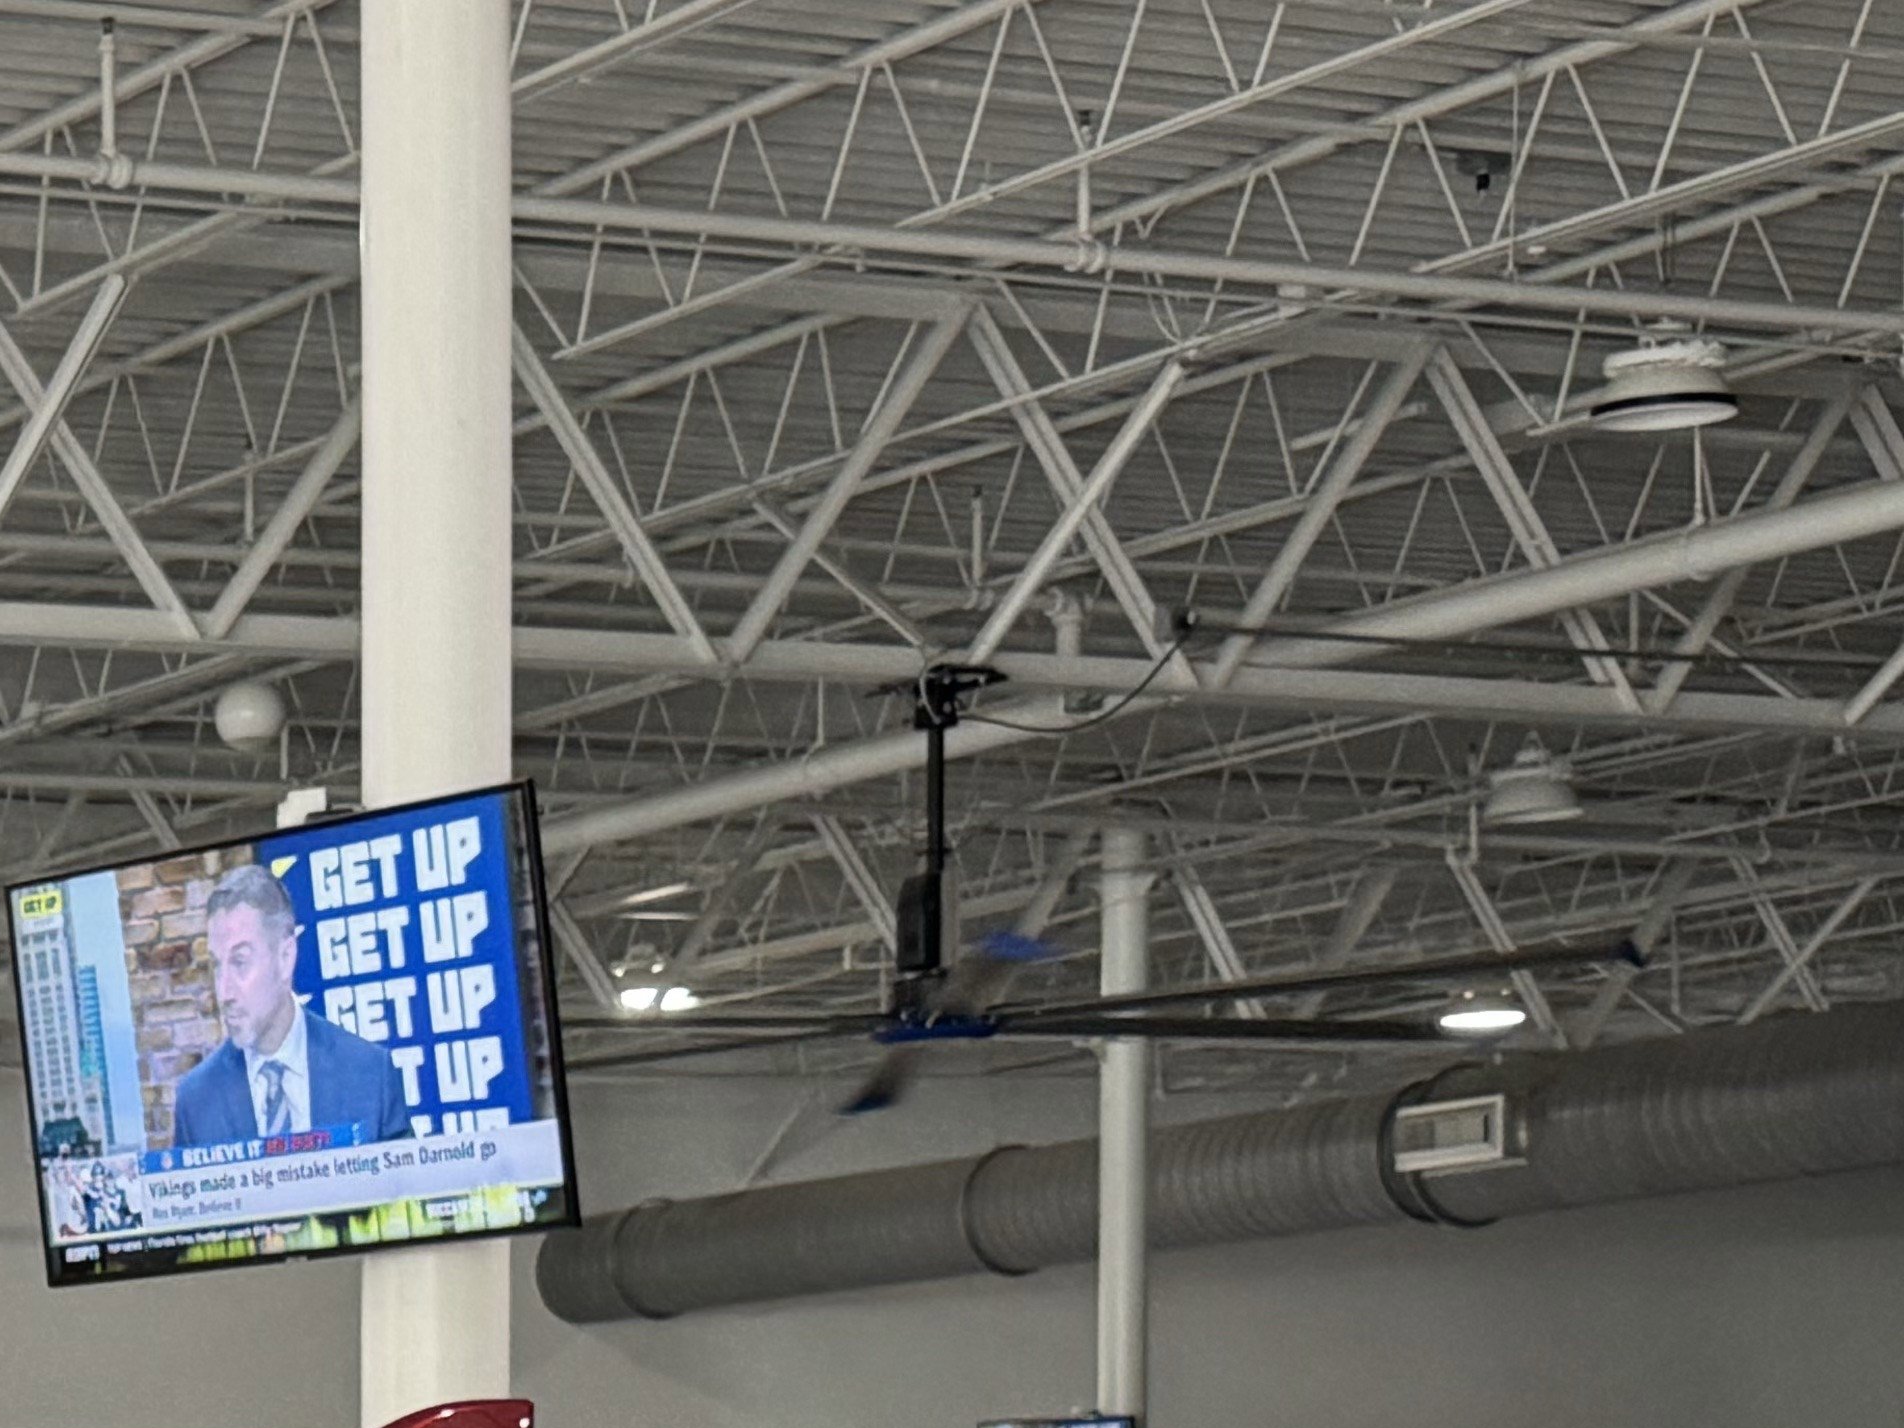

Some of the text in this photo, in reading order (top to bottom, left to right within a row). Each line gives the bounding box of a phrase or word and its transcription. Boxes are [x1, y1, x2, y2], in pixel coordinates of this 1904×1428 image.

[309, 816, 481, 912] GET UP
[316, 890, 489, 980] GET UP
[323, 963, 496, 1043] GET UP
[434, 1035, 505, 1104] UP
[148, 1140, 497, 1200] Vikings made a big mistake letting Sam Darnold go
[182, 1139, 245, 1168] BELIEVE
[247, 1138, 263, 1159] IT
